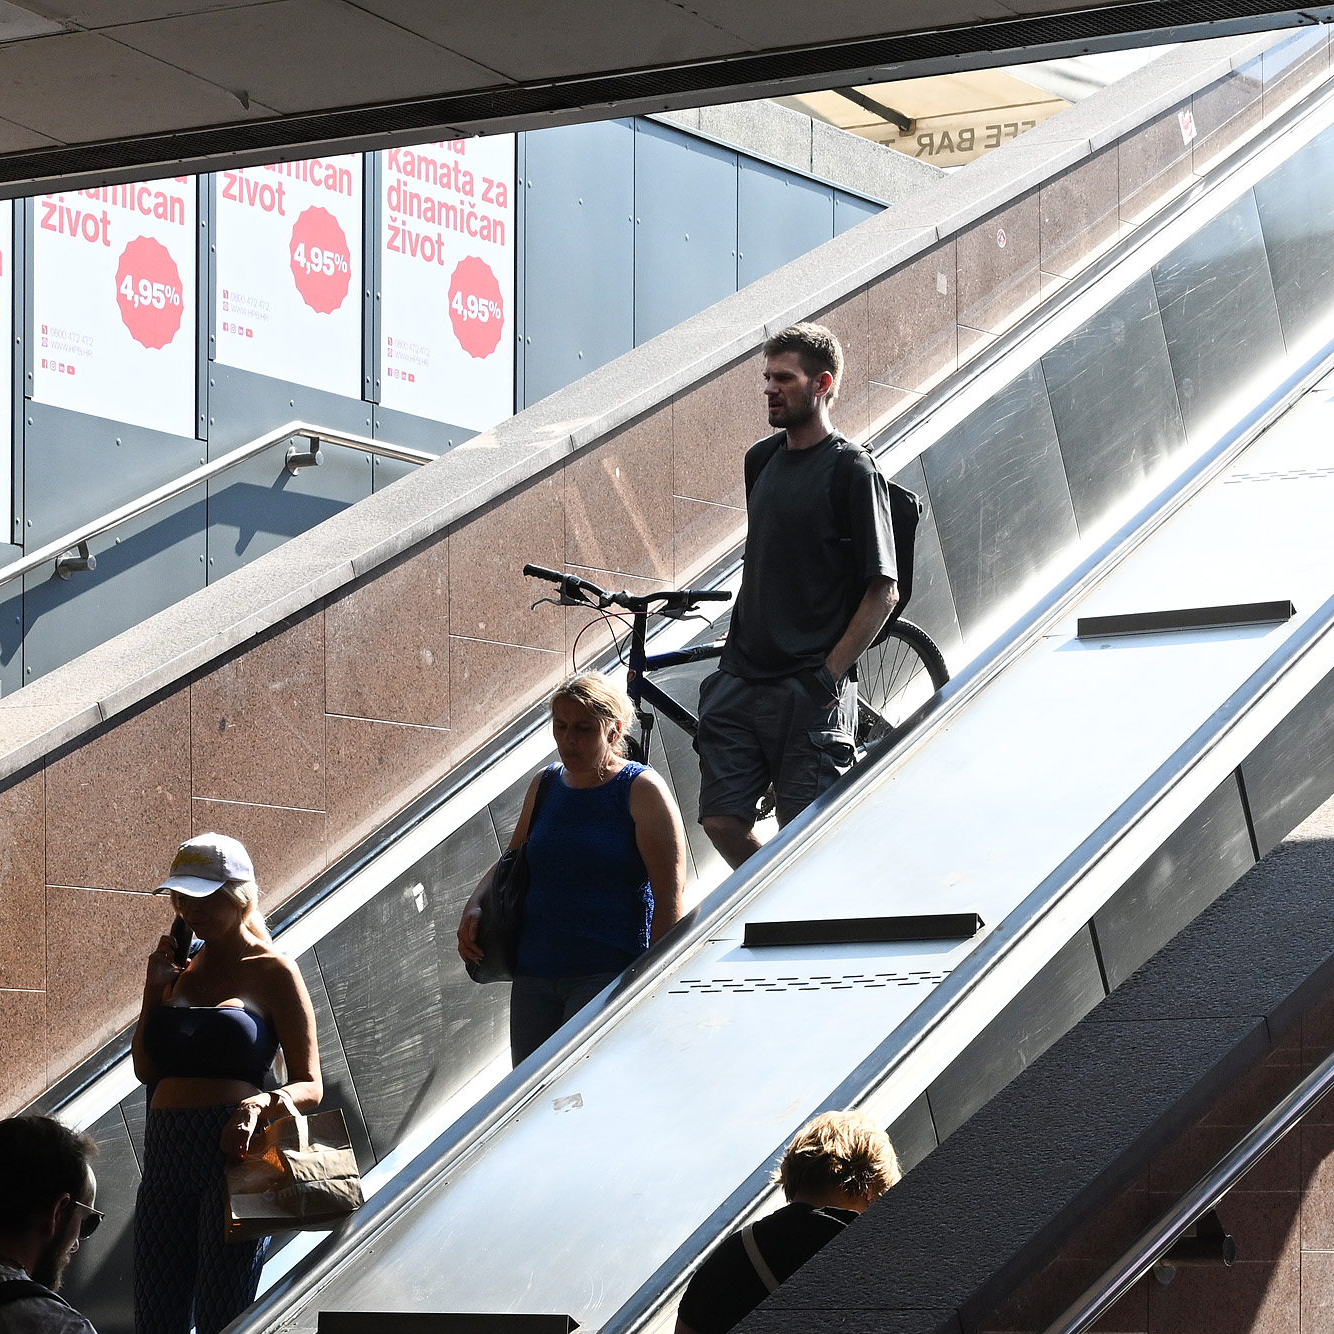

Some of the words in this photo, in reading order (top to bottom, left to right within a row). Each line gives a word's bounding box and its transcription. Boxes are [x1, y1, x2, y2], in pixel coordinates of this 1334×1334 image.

[482, 176, 508, 209] za
[40, 194, 111, 247] život
[387, 178, 505, 246] dinamičan
[293, 242, 348, 276] 4,95%
[387, 215, 445, 267] život
[119, 274, 180, 310] 4,95%
[451, 288, 503, 324] 4,95%
[50, 327, 67, 340] 0800
